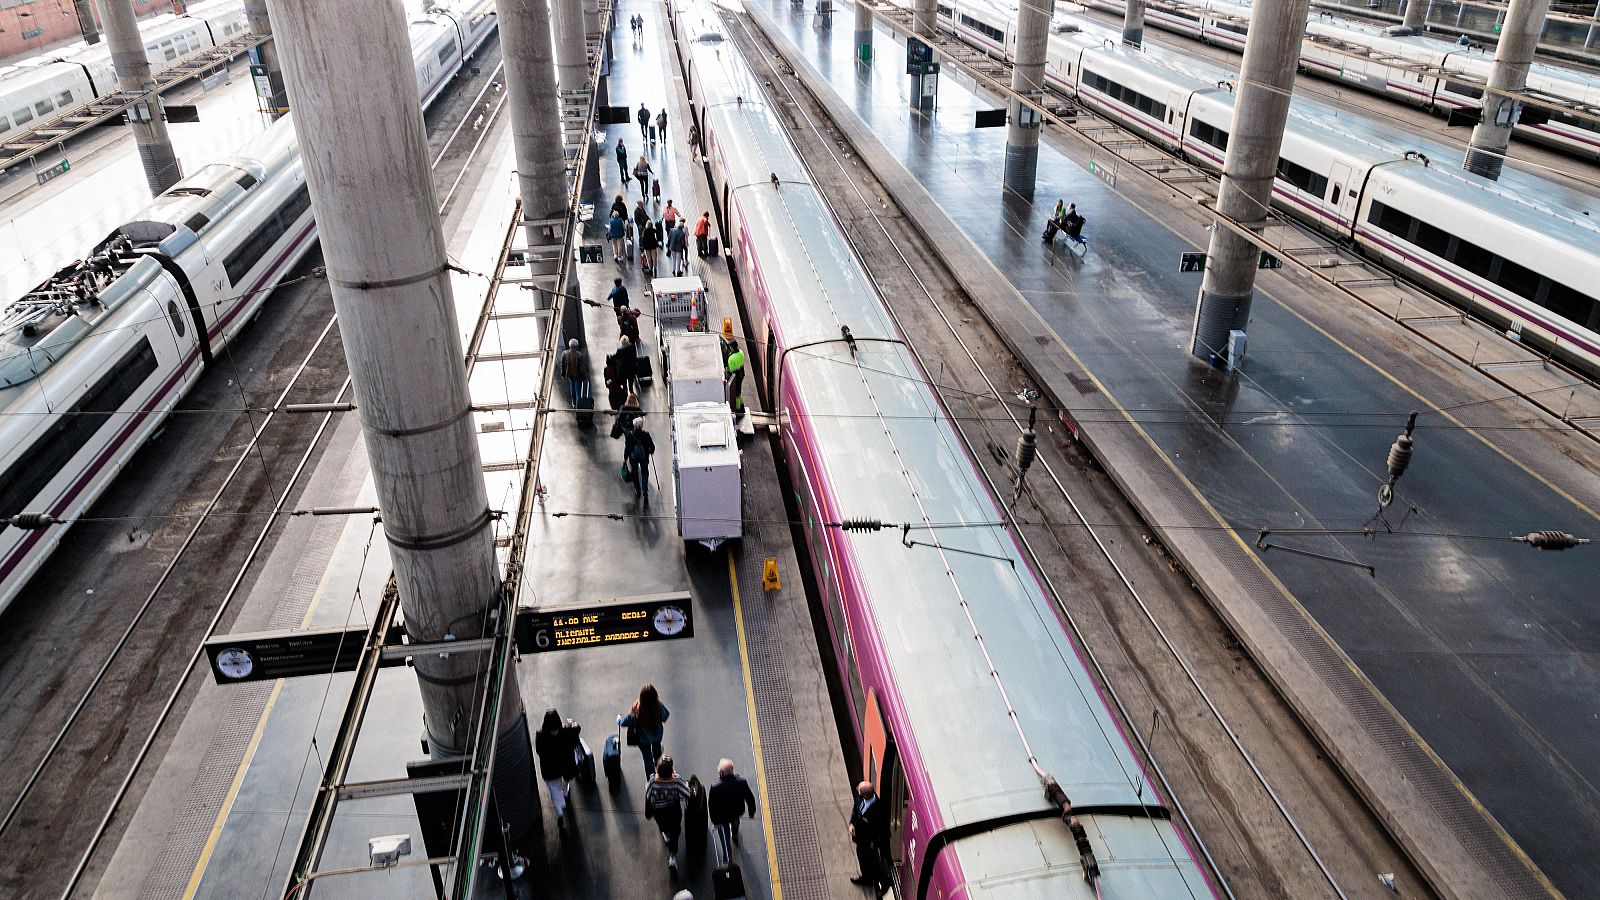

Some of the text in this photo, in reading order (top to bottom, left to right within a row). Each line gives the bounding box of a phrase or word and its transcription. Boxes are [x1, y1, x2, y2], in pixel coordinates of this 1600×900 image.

[586, 253, 603, 263] A 6
[1264, 258, 1271, 268] A
[1182, 261, 1199, 271] 7 A
[555, 628, 595, 639] ALICANTE
[536, 629, 550, 649] 6
